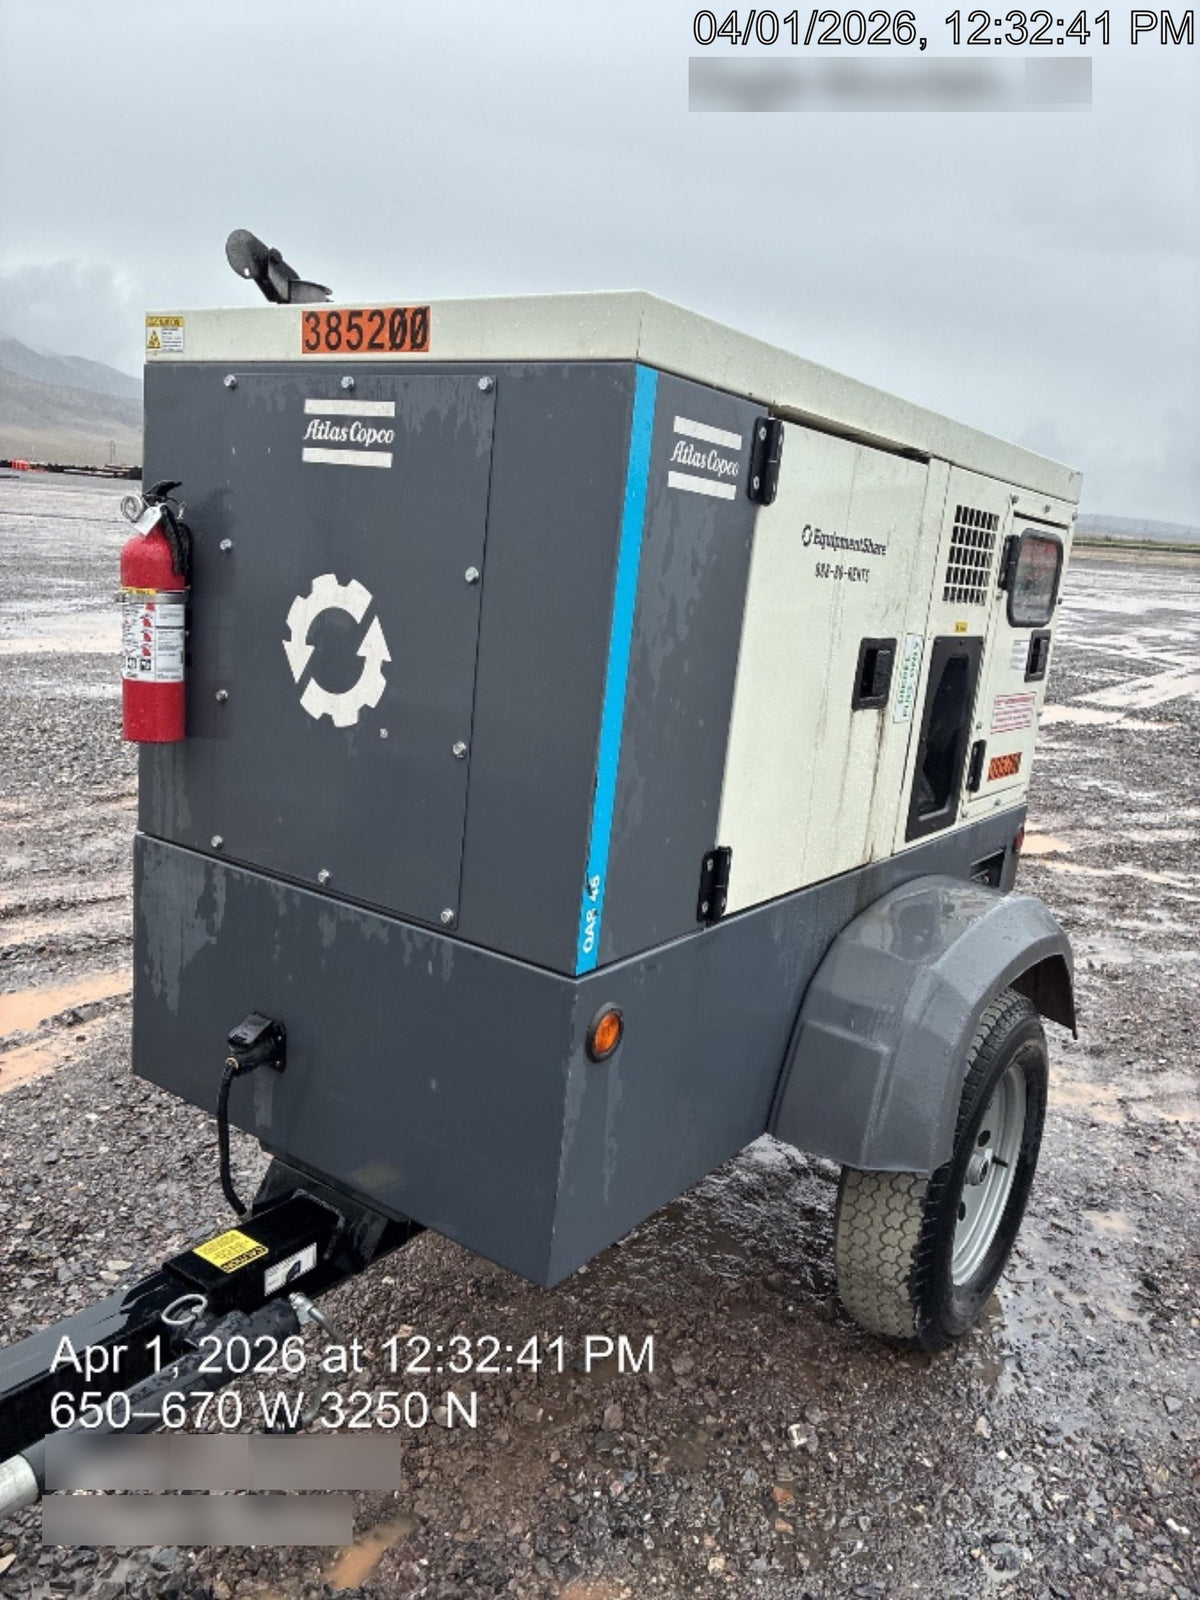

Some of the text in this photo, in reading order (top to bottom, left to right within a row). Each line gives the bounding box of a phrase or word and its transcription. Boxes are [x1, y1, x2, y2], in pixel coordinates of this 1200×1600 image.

[304, 306, 427, 351] 385200
[303, 419, 395, 447] Atlas Copco
[669, 440, 740, 477] Atlas Copco
[813, 527, 886, 556] EquipmentShare
